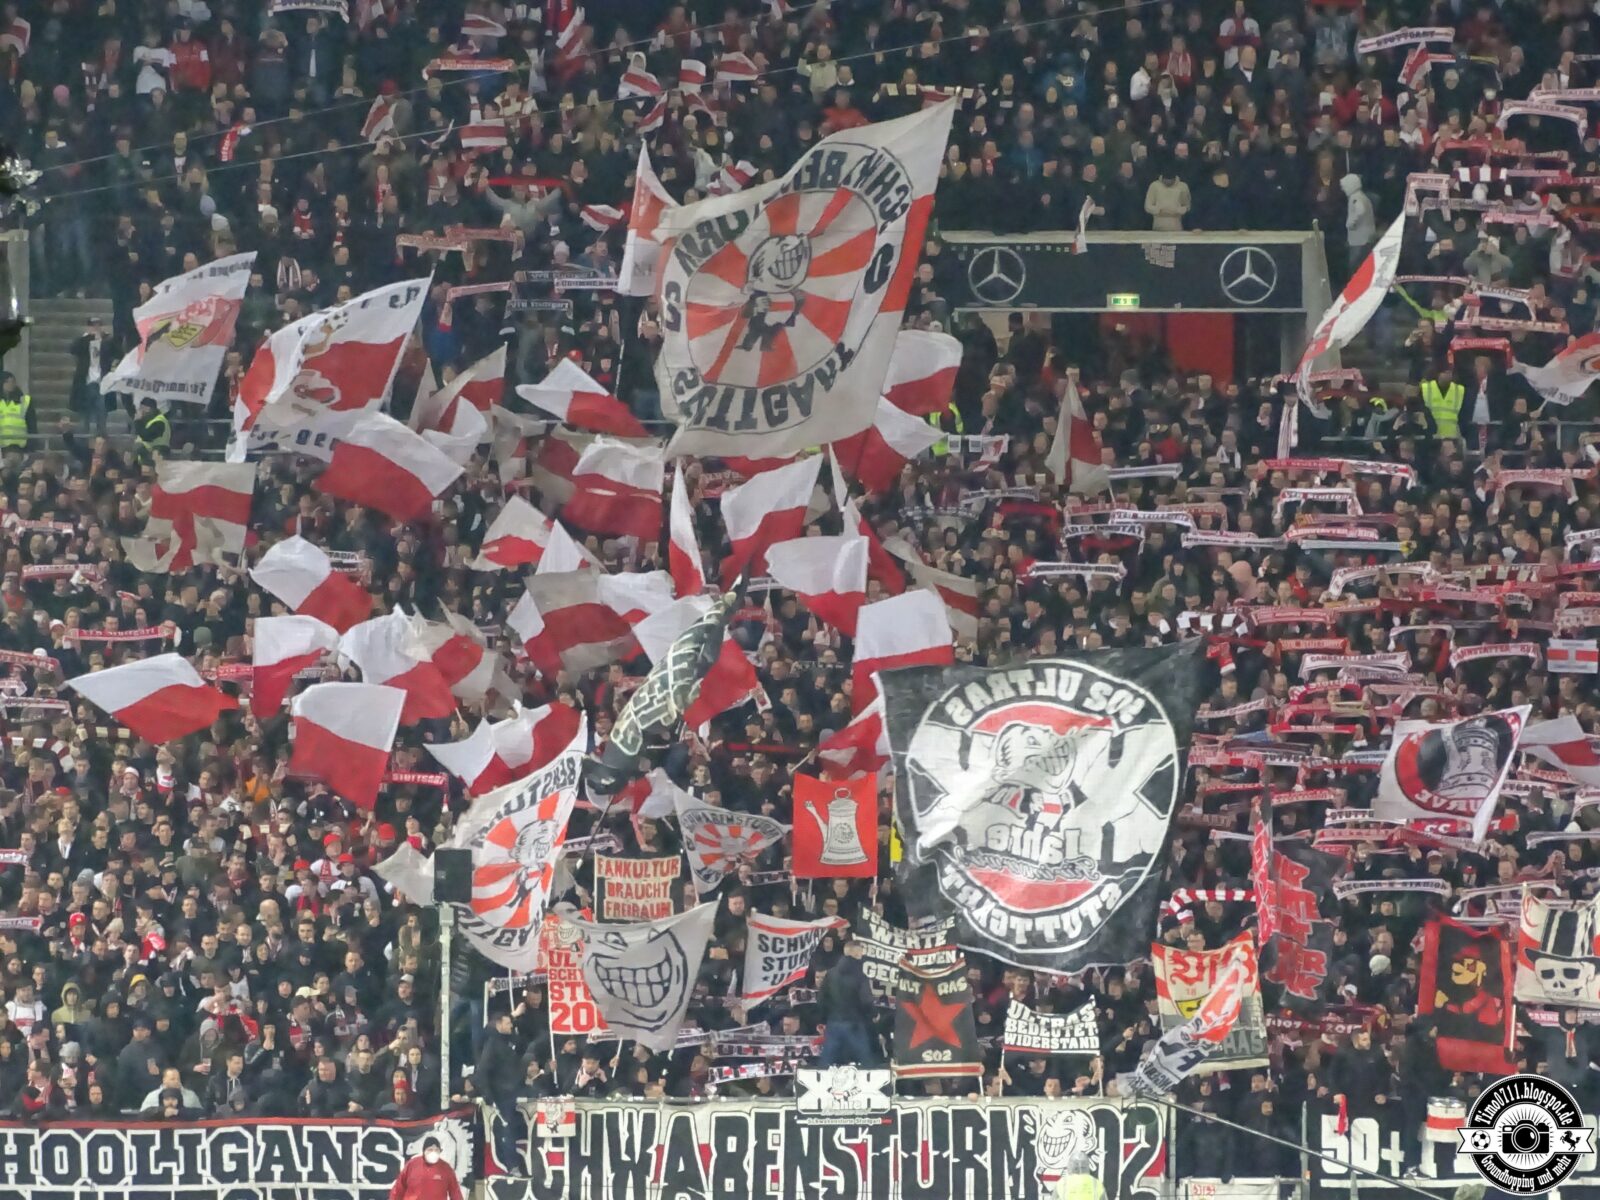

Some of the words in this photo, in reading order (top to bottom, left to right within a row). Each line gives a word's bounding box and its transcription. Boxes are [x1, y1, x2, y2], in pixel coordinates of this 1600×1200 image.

[596, 856, 681, 878] FANKULTUR
[606, 880, 670, 899] BRAUCHT
[605, 902, 672, 919] FREIRAUM
[869, 923, 948, 950] WERTE
[908, 950, 957, 967] JEDEN
[1008, 999, 1097, 1028] ULTRAS
[1004, 1031, 1100, 1051] WIDERSTAND
[0, 1125, 404, 1188] HOOLIGANS
